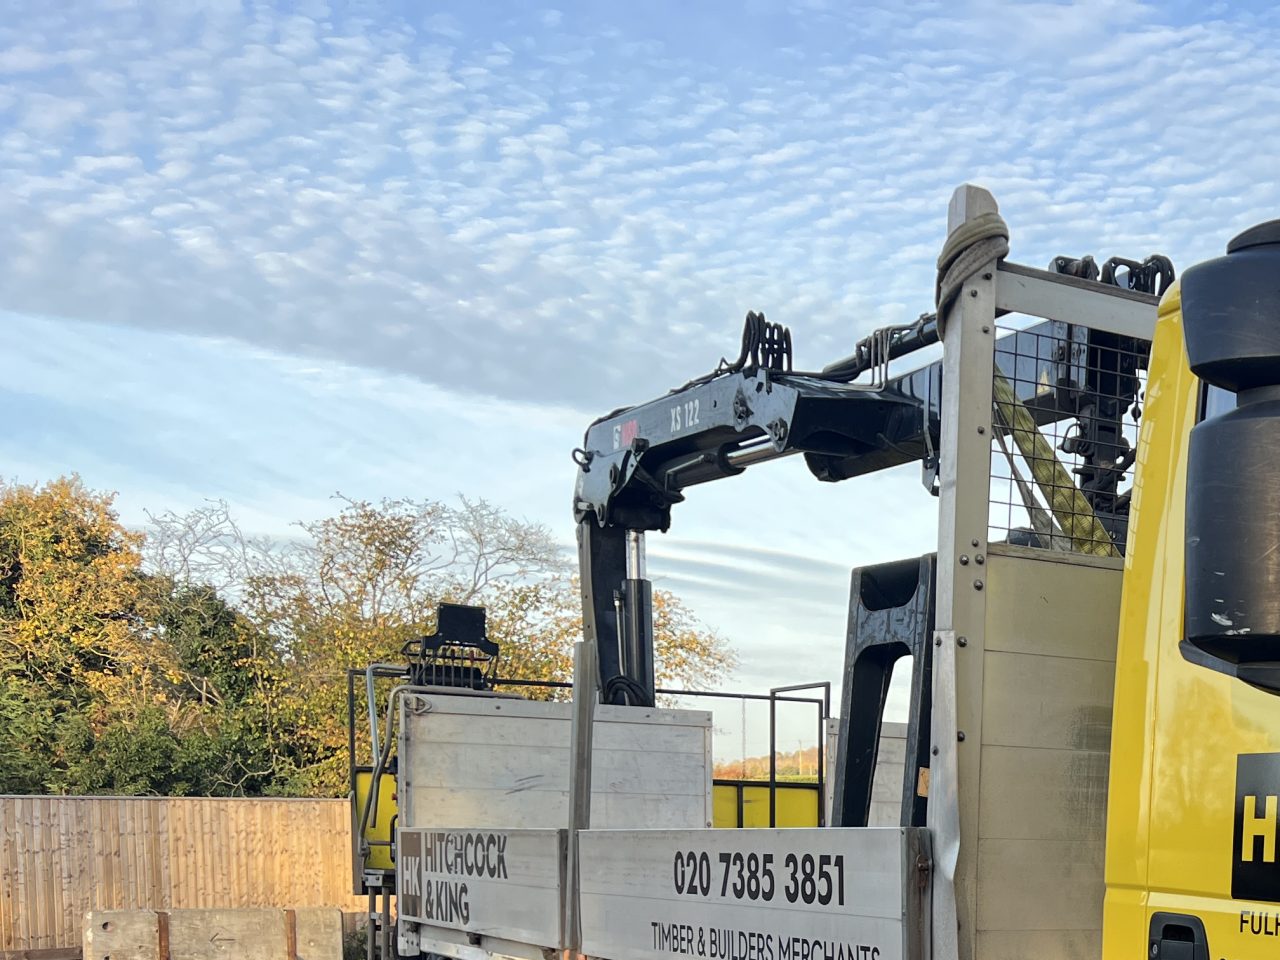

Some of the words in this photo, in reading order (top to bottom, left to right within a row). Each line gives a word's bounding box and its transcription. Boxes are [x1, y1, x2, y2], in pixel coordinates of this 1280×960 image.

[670, 405, 682, 433] XS
[684, 398, 700, 428] 122
[402, 856, 421, 897] HK
[424, 832, 508, 880] HITCHCOCK
[673, 850, 711, 897] 020
[719, 852, 775, 902] 7385
[784, 852, 845, 906] 3851
[425, 879, 434, 920] &
[435, 880, 470, 926] KING
[651, 921, 694, 956] TIMBER
[697, 925, 706, 956] &
